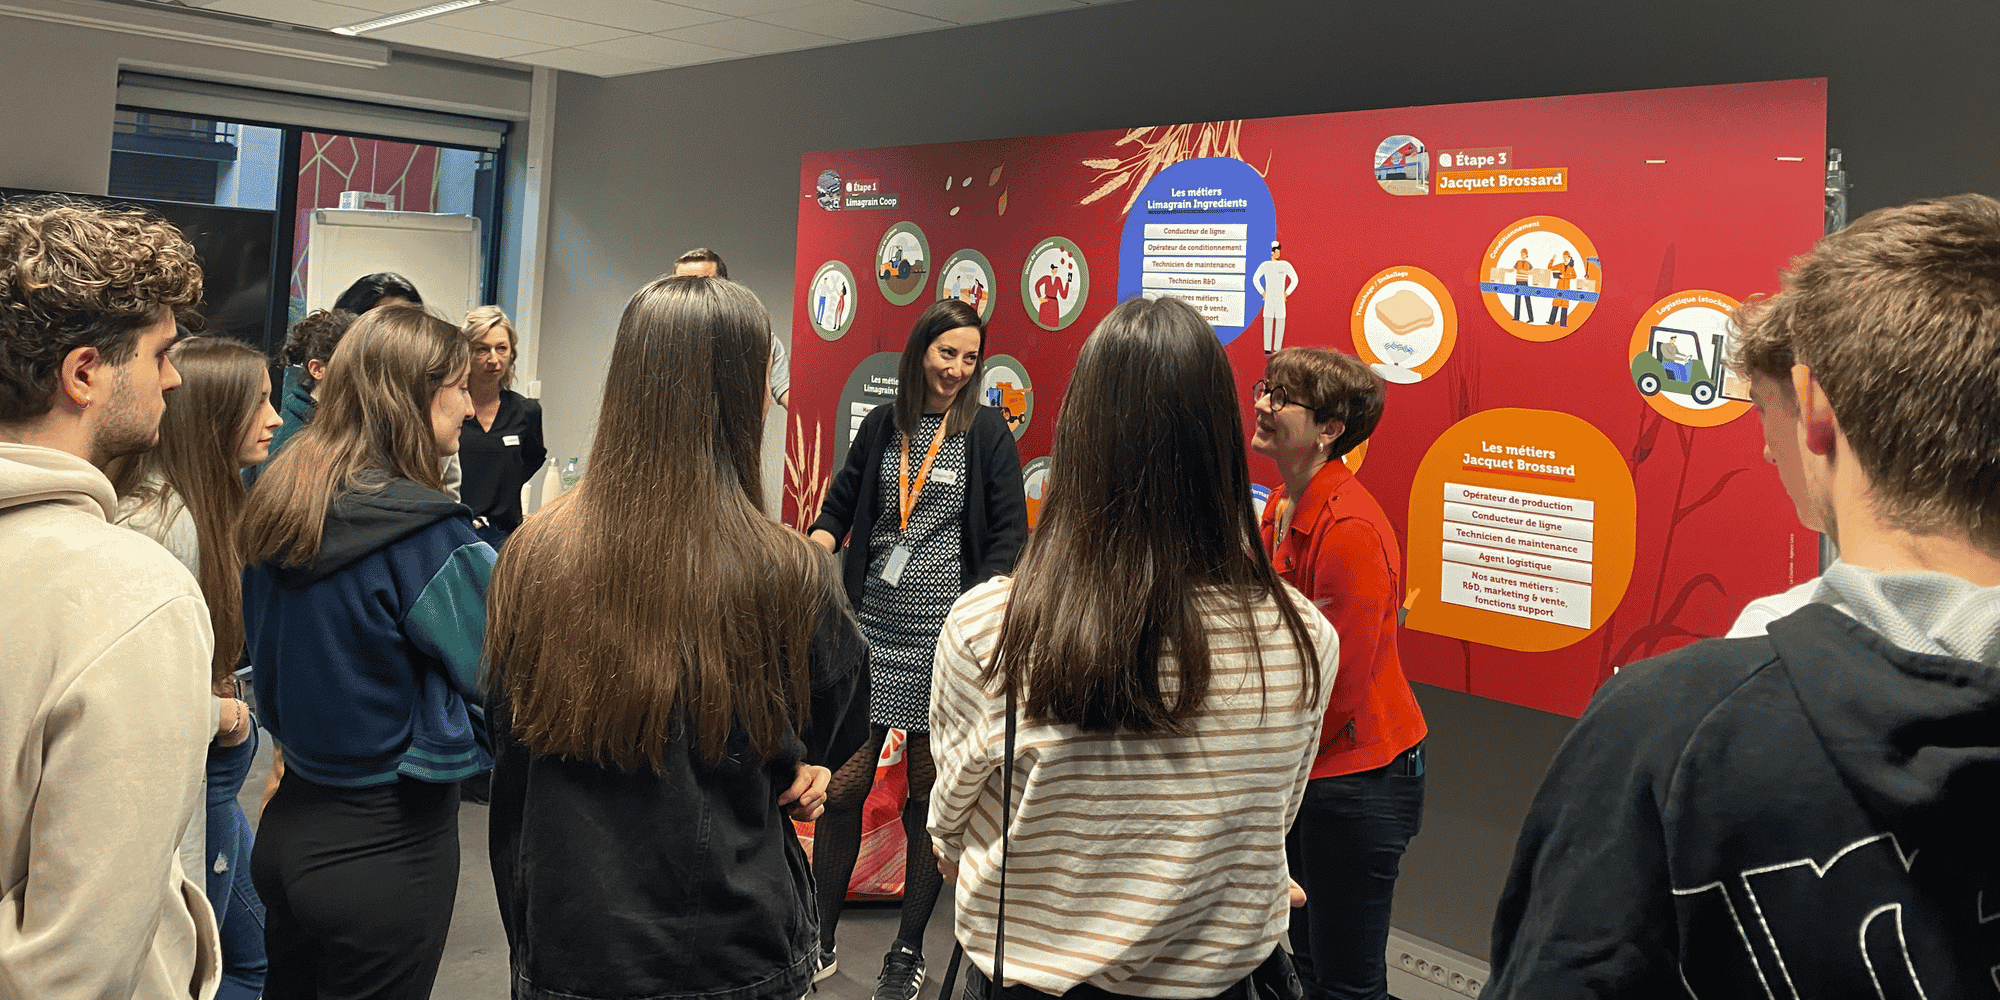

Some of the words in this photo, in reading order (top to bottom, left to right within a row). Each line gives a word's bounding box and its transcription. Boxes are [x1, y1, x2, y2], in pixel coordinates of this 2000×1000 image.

[1456, 151, 1494, 168] Étape
[1498, 152, 1507, 164] 3
[853, 182, 871, 193] Étape
[873, 182, 877, 191] 1
[1440, 175, 1495, 190] Jacquet
[1498, 173, 1562, 187] Brossard
[1171, 187, 1186, 197] Les
[1187, 187, 1222, 197] métiers
[845, 197, 879, 208] Limagrain
[879, 197, 897, 207] Coop
[1147, 200, 1192, 211] Limagrain
[1193, 198, 1248, 210] Ingredients
[1210, 228, 1226, 237] ligne
[1490, 221, 1540, 259] Conditionnement
[1147, 244, 1178, 252] Opérateur
[1194, 261, 1236, 269] maintenance
[1169, 277, 1202, 285] Technicien
[1195, 294, 1220, 302] métiers
[1355, 286, 1375, 316] Tranchage
[1377, 271, 1409, 283] Emballage
[1209, 304, 1229, 312] vente,
[1656, 296, 1697, 315] Logistique
[1698, 295, 1733, 312] (stockag
[871, 375, 881, 384] Les
[881, 376, 899, 386] métie
[863, 384, 895, 395] Limagrain
[1481, 441, 1503, 453] Les
[1506, 445, 1556, 460] métiers
[1463, 453, 1514, 470] Jacquet
[1516, 459, 1576, 477] Brossard
[1462, 489, 1507, 503] Opérateur
[1508, 496, 1520, 505] de
[1521, 499, 1573, 512] production
[1471, 511, 1524, 525] Conducteur
[1525, 519, 1537, 528] de
[1538, 521, 1562, 531] ligne
[1456, 528, 1503, 543] Technicien
[1505, 534, 1516, 544] de
[1518, 539, 1578, 554] maintenance
[1478, 552, 1505, 564] Agent
[1506, 556, 1552, 571] logistique
[1471, 571, 1488, 581] Nos
[1489, 575, 1518, 587] autres
[1519, 579, 1554, 593] métiers
[1462, 581, 1483, 593] R&D,
[1484, 586, 1530, 603] marketing
[1531, 594, 1539, 602] &
[1540, 595, 1568, 608] vente,
[1475, 595, 1516, 610] fonctions
[1518, 603, 1554, 617] support
